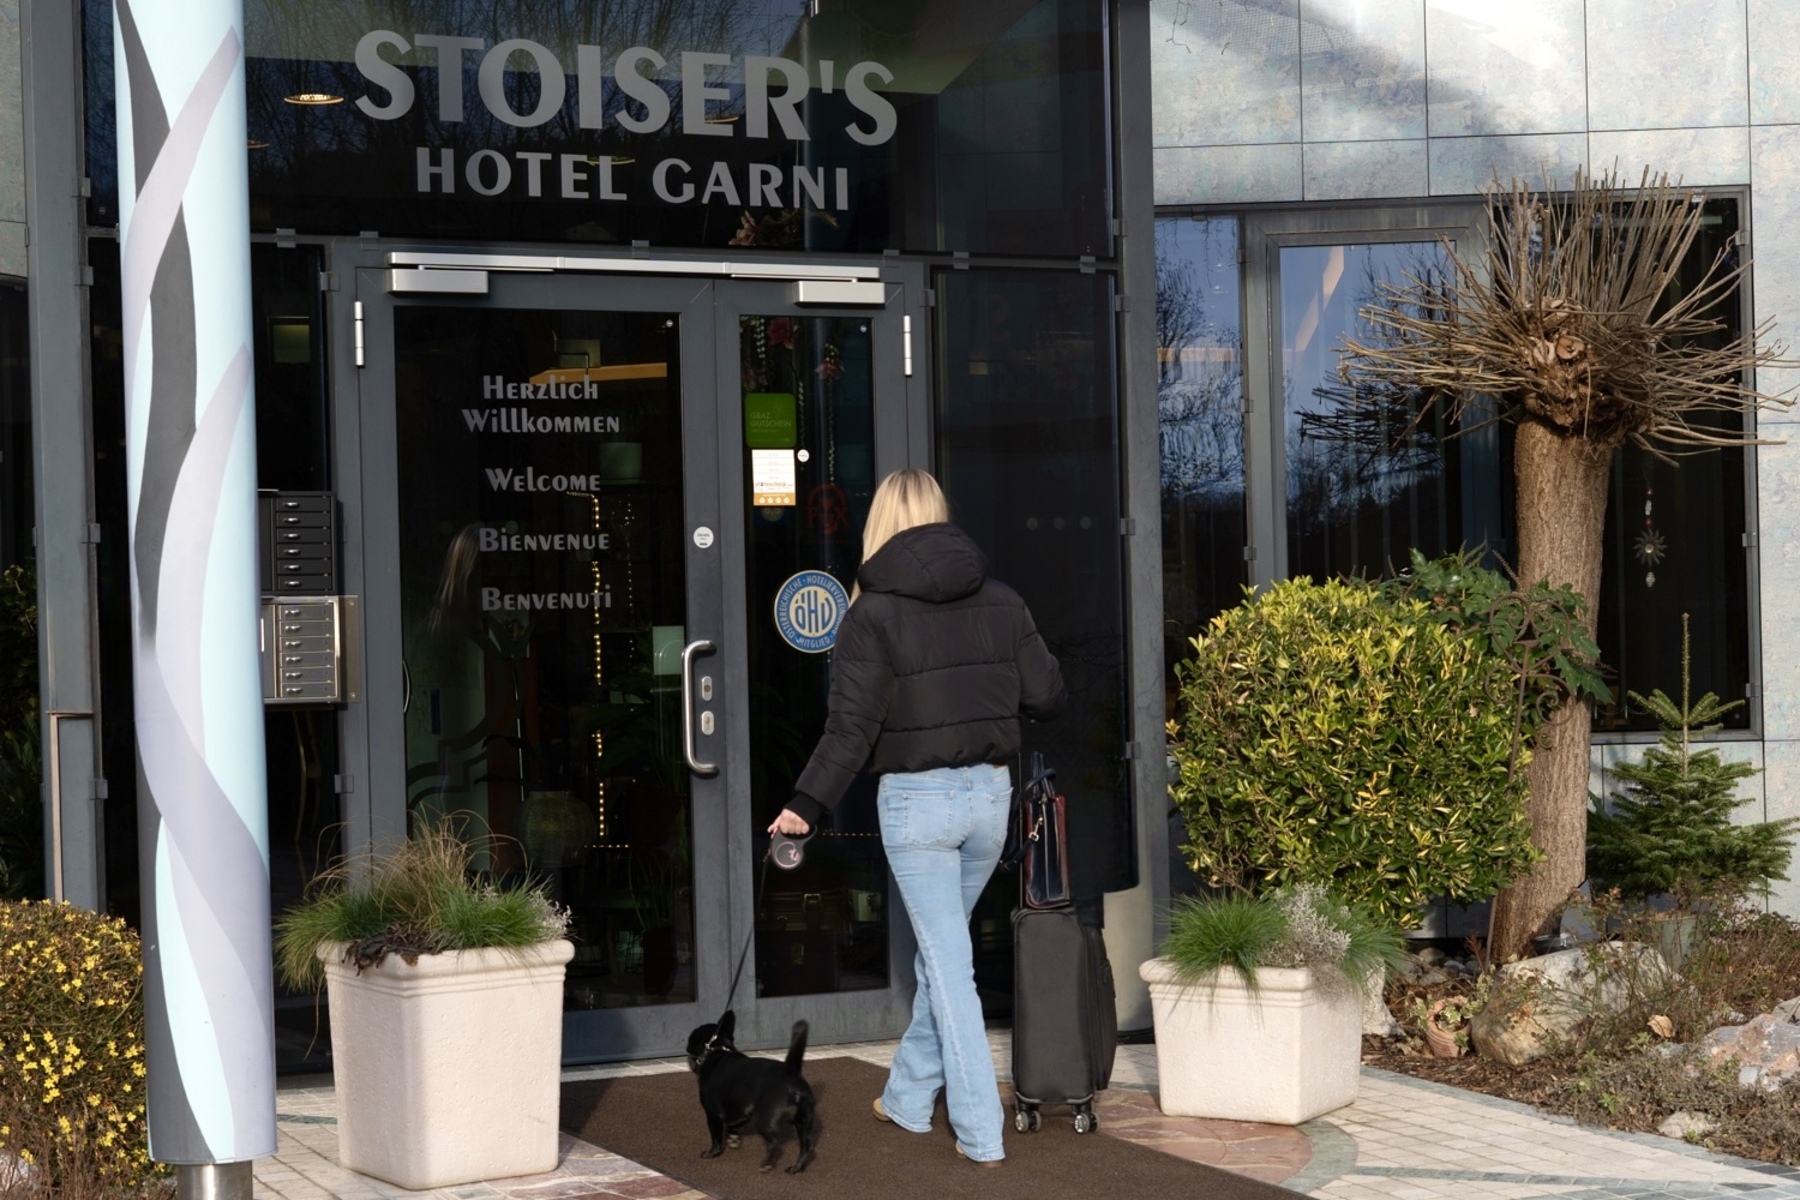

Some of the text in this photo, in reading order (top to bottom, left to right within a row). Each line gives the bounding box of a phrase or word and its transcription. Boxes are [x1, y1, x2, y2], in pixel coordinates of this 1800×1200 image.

[354, 29, 897, 147] STOISER'S
[416, 146, 849, 211] HOTEL GARNI
[750, 411, 771, 420] GRAZ
[485, 466, 600, 492] Welcome
[796, 636, 831, 648] MITGLIED
